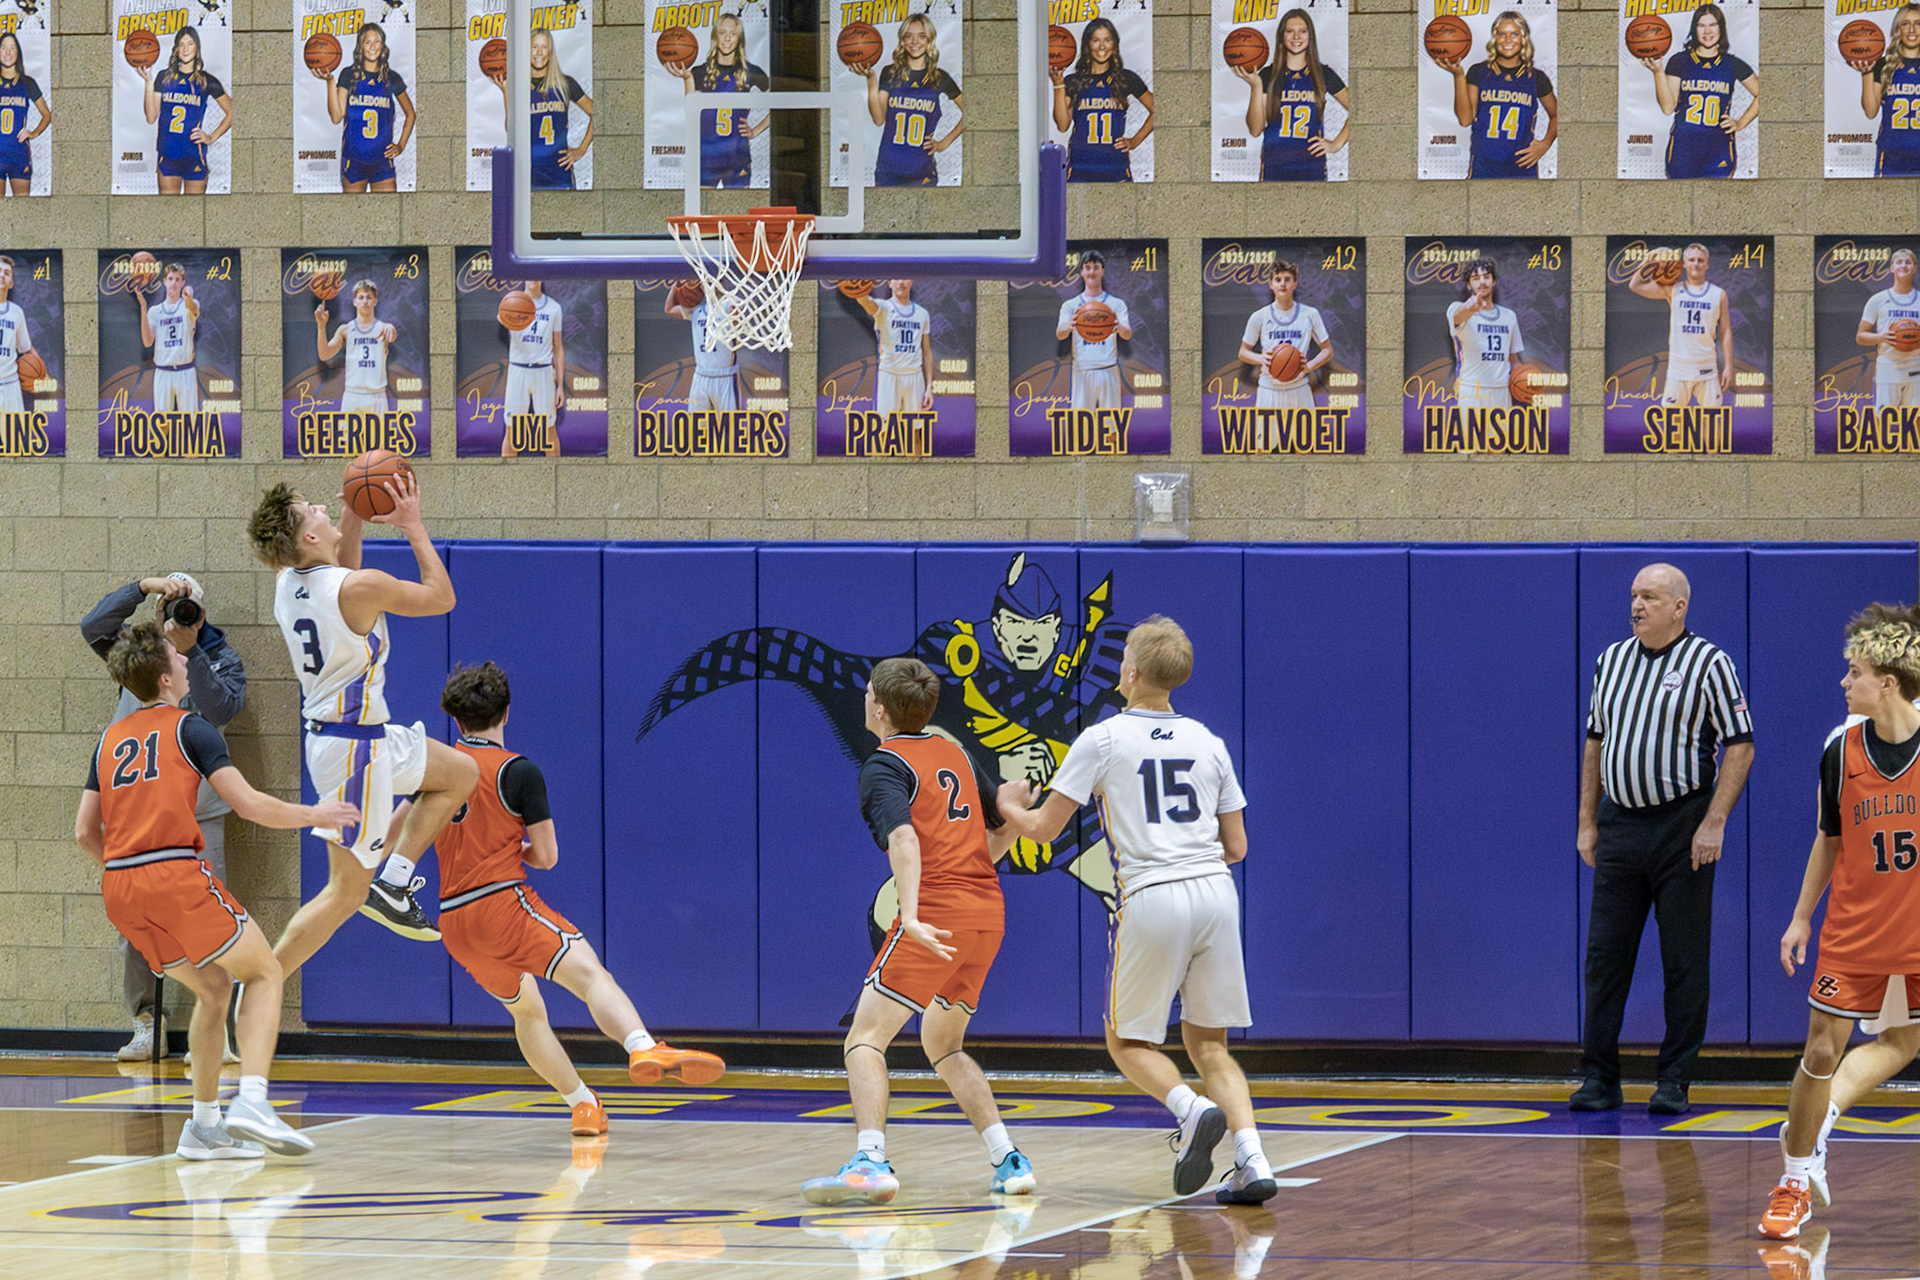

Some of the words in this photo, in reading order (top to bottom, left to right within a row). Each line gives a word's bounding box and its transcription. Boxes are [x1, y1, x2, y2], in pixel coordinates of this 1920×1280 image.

[652, 1, 723, 33] ABBOTT
[840, 0, 909, 29] TERRYN
[1232, 0, 1279, 24] KING
[1625, 0, 1713, 18] HILEMA
[116, 9, 189, 41] BRISENO
[301, 9, 365, 41] FOSTER
[1480, 90, 1532, 107] CALEDONIA
[1681, 79, 1730, 95] CALEDONIA
[1, 108, 14, 135] 0
[169, 106, 186, 133] 2
[363, 109, 379, 139] 3
[716, 108, 732, 137] 5
[1279, 105, 1312, 140] 12
[1486, 105, 1521, 141] 14
[1685, 94, 1721, 127] 20
[1891, 98, 1920, 130] 23
[539, 115, 555, 145] 4
[892, 112, 926, 147] 10
[1086, 112, 1113, 144] 11
[1430, 135, 1457, 145] JUNIOR
[1627, 134, 1653, 144] JUNIOR
[1827, 133, 1873, 144] SOPHOMORE
[298, 150, 337, 161] SOPHOMORE
[1221, 138, 1247, 148] SENIOR
[113, 261, 162, 274] 2025/2026
[297, 260, 346, 273] 2025/2026
[394, 253, 420, 280] #3
[1130, 247, 1158, 273] #11
[1203, 242, 1276, 286] Cal
[1220, 251, 1275, 264] 2025/2026
[1322, 245, 1356, 271] #12
[1406, 241, 1466, 285] Ca
[1527, 244, 1561, 271] #13
[1729, 244, 1764, 270] #14
[1816, 240, 1891, 284] Cal
[1833, 248, 1889, 261] 2025/2026
[33, 256, 51, 281] #1
[100, 253, 163, 295] Cal
[206, 257, 232, 281] #2
[283, 252, 348, 295] Cal
[531, 321, 538, 334] 4
[1686, 309, 1701, 325] 14
[169, 325, 177, 339] 2
[901, 329, 913, 344] 10
[1268, 329, 1302, 340] FIGHTING
[1487, 335, 1502, 351] 13
[362, 346, 370, 360] 3
[940, 359, 967, 373] GUARD
[209, 379, 234, 393] GUARD
[396, 377, 422, 391] GUARD
[573, 377, 599, 391] GUARD
[754, 377, 781, 391] GUARD
[1134, 373, 1162, 388] GUARD
[1329, 372, 1358, 388] GUARD
[1527, 372, 1568, 388] FORWARD
[1735, 372, 1765, 387] GUARD
[291, 381, 334, 418] Ben
[824, 379, 872, 413] Logan
[1133, 395, 1163, 408] JUNIOR
[1328, 394, 1359, 408] SENIOR
[1531, 393, 1563, 408] SENIOR
[1734, 394, 1765, 408] JUNIOR
[115, 411, 226, 458] POSTMA
[298, 411, 417, 457] GEERDES
[510, 413, 553, 452] UYL
[639, 410, 787, 456] BLOEMERS
[846, 410, 938, 456] PRATT
[1047, 407, 1133, 455] TIDEY
[1219, 406, 1350, 454] WITVOET
[1423, 404, 1549, 452] HANSON
[1643, 405, 1732, 453] SENTI
[1837, 405, 1920, 453] BACK
[293, 618, 324, 675] 3
[1151, 728, 1175, 741] Cal
[111, 730, 161, 790] 21
[937, 768, 970, 823] 2
[1136, 758, 1201, 824] 15
[1854, 793, 1920, 827] BULLDO
[1872, 830, 1918, 874] 15
